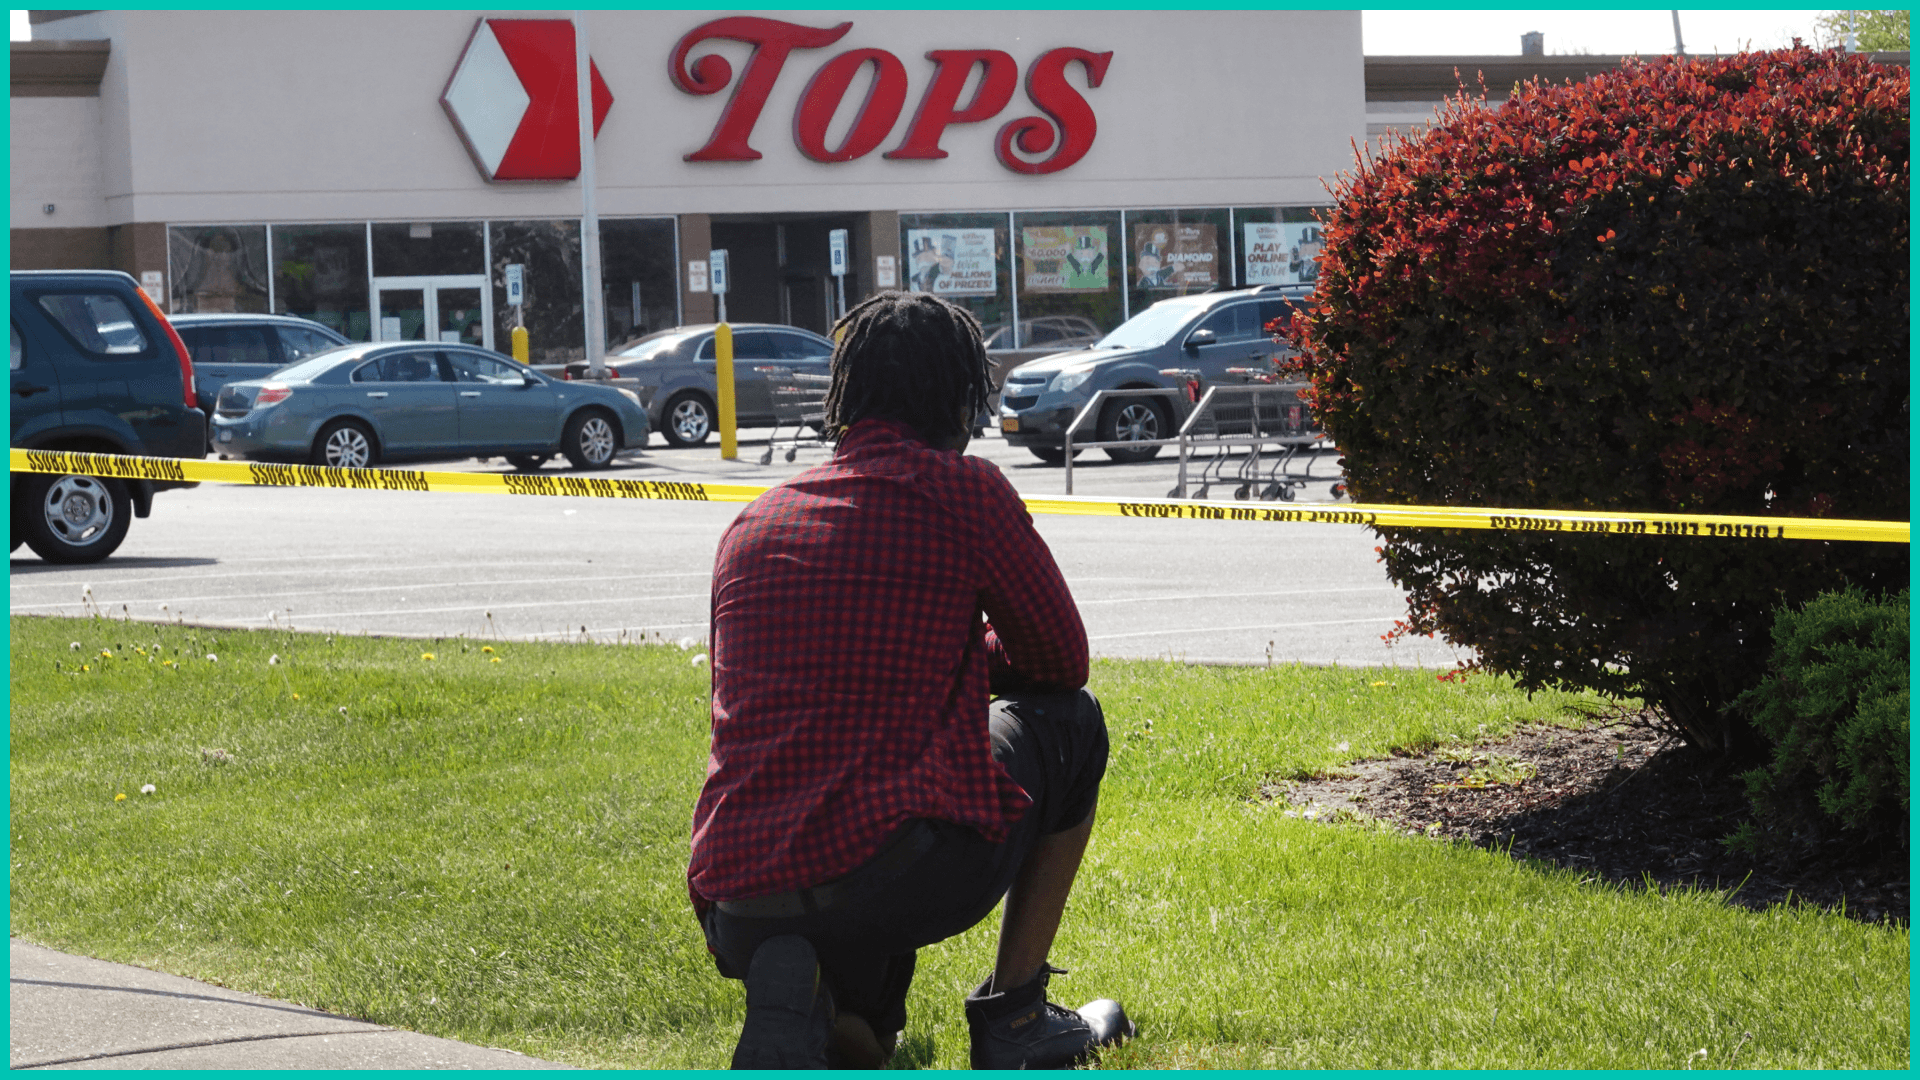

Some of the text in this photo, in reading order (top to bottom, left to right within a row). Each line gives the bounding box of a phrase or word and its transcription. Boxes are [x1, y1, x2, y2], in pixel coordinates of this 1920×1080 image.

[1254, 242, 1281, 252] PLAY
[1166, 252, 1213, 262] DIAMOND
[1248, 253, 1288, 262] ONLINE
[938, 279, 993, 289] OF PRIZES!
[27, 450, 184, 480] POLICE LINE DO NOT CROSS
[250, 462, 430, 491] POLICE LINE DO NOT CROSS
[502, 474, 708, 500] POLICE LINE DO NOT CROSS
